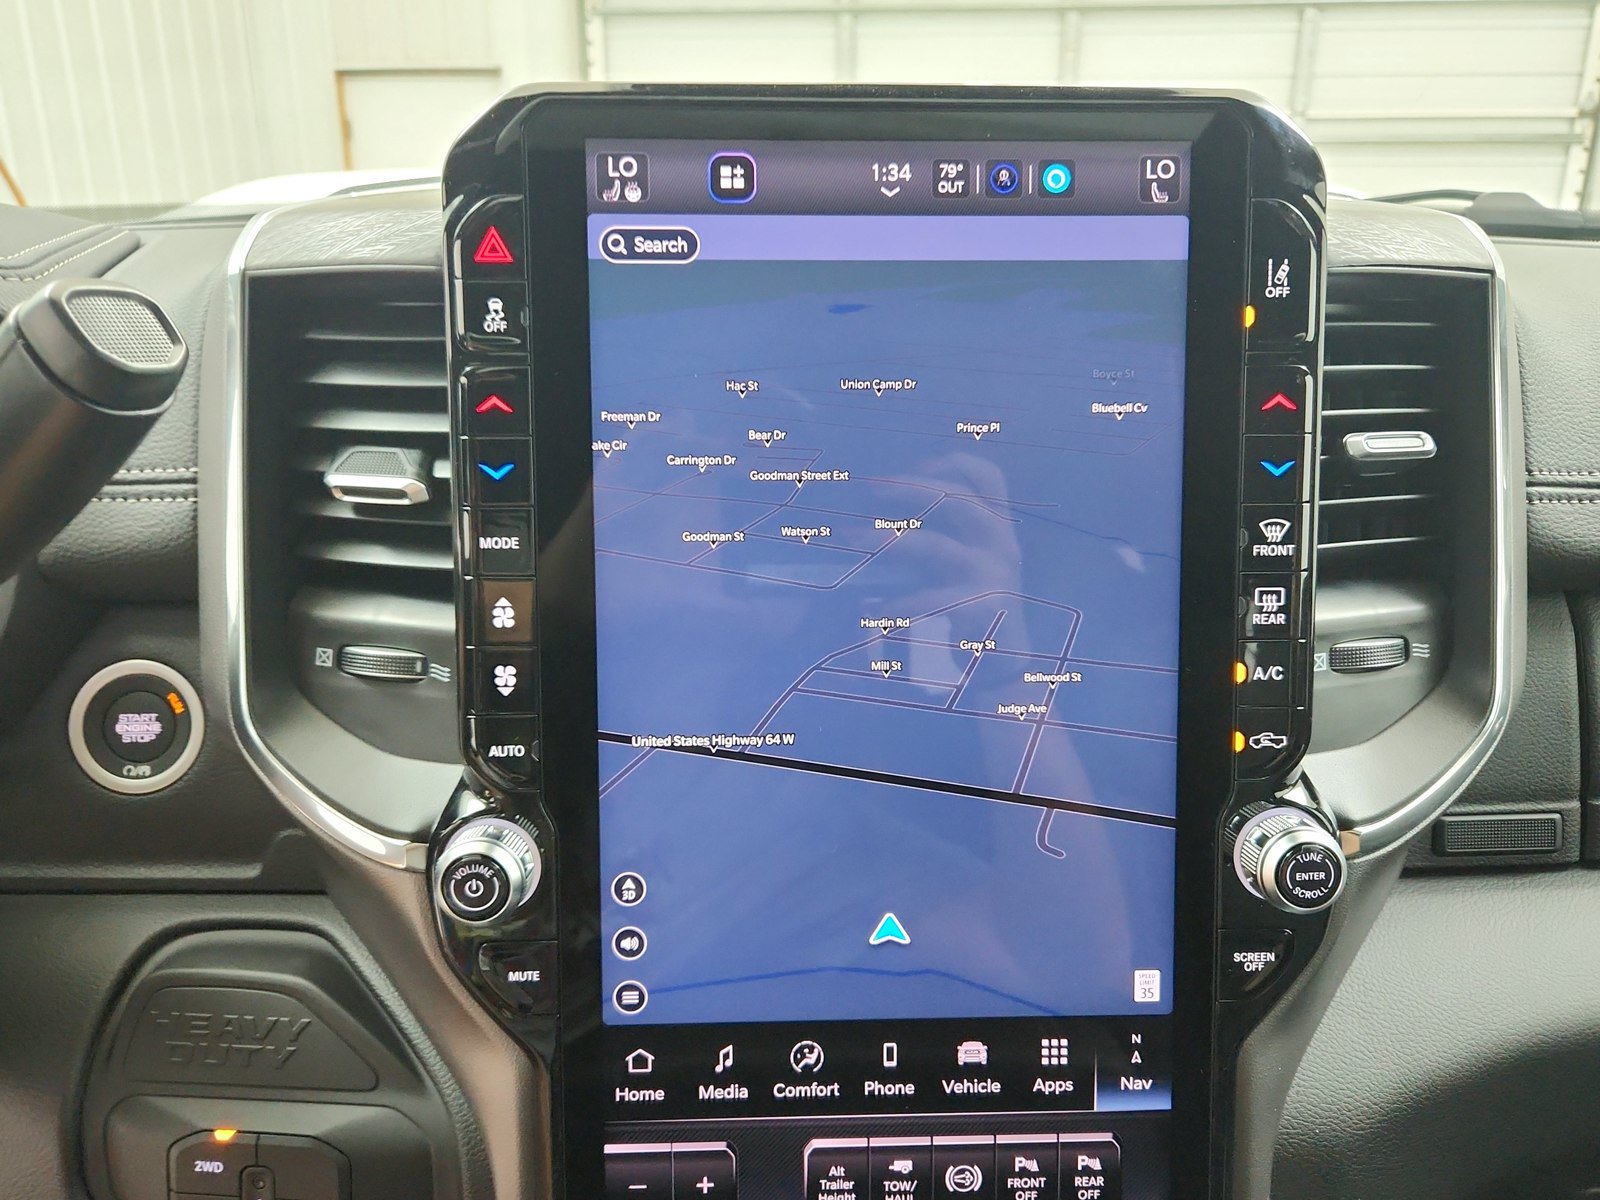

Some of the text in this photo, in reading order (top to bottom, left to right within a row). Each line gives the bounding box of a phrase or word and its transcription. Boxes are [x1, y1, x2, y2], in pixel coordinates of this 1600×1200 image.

[607, 156, 638, 178] LO
[872, 162, 912, 182] 1:34
[939, 163, 964, 178] 79°
[1146, 159, 1176, 180] LO
[938, 180, 964, 194] OUT
[634, 236, 688, 254] Search
[1265, 286, 1290, 298] OFF
[482, 320, 508, 333] OFF
[1092, 369, 1135, 380] Boyce St
[726, 381, 758, 391] Hac St
[840, 379, 917, 391] Union Camp Dr
[1090, 402, 1149, 413] Bluebell Cv
[600, 411, 662, 422] Freeman Dr
[956, 422, 988, 433] Prince
[748, 430, 786, 440] Bear Dr
[612, 440, 628, 450] Cir
[666, 455, 737, 467] Carrington Dr
[750, 471, 850, 481] Goodman Street Ext
[874, 520, 922, 529] Blount Dr
[781, 526, 831, 536] Watson St
[682, 532, 745, 542] Goodman St
[479, 536, 520, 550] MODE
[1252, 544, 1296, 556] FRONT
[860, 618, 910, 628] Hardin Rd
[1252, 614, 1286, 625] REAR
[960, 640, 996, 651] Gray St
[871, 661, 902, 671] Mill St
[1024, 672, 1082, 682] Bellwood St
[1253, 666, 1284, 681] A/C
[997, 704, 1048, 714] Judge Ave
[118, 713, 158, 722] START
[115, 722, 162, 733] ENGINE
[122, 734, 156, 744] STOP
[631, 734, 795, 748] United States Highway 64 W
[488, 745, 526, 758] AUTO
[1296, 852, 1324, 864] TUNE
[452, 864, 494, 880] VOLUME
[1296, 872, 1326, 881] ENTER
[622, 890, 636, 900] 3D
[1292, 886, 1330, 900] SCROLL
[1233, 952, 1276, 962] SCREEN
[1244, 962, 1265, 972] OFF
[508, 970, 540, 981] MUTE
[1140, 988, 1154, 998] 35
[150, 1010, 312, 1040] HEAVY
[1131, 1034, 1142, 1044] N
[165, 1040, 298, 1070] DUTY
[864, 1080, 915, 1096] Phone
[942, 1079, 1001, 1094] Vehicle
[1033, 1078, 1074, 1094] Apps
[1120, 1076, 1152, 1090] Nav
[615, 1088, 665, 1102] Home
[698, 1084, 749, 1100] Media
[773, 1082, 840, 1098] Comfort
[194, 1160, 224, 1173] 2WD
[828, 1166, 846, 1176] Alt
[820, 1180, 855, 1190] Trailer
[883, 1180, 918, 1192] TOW/
[1007, 1178, 1046, 1188] FRONT
[1074, 1176, 1104, 1187] REAR
[1015, 1191, 1038, 1200] OFF
[1078, 1190, 1100, 1200] OFF
